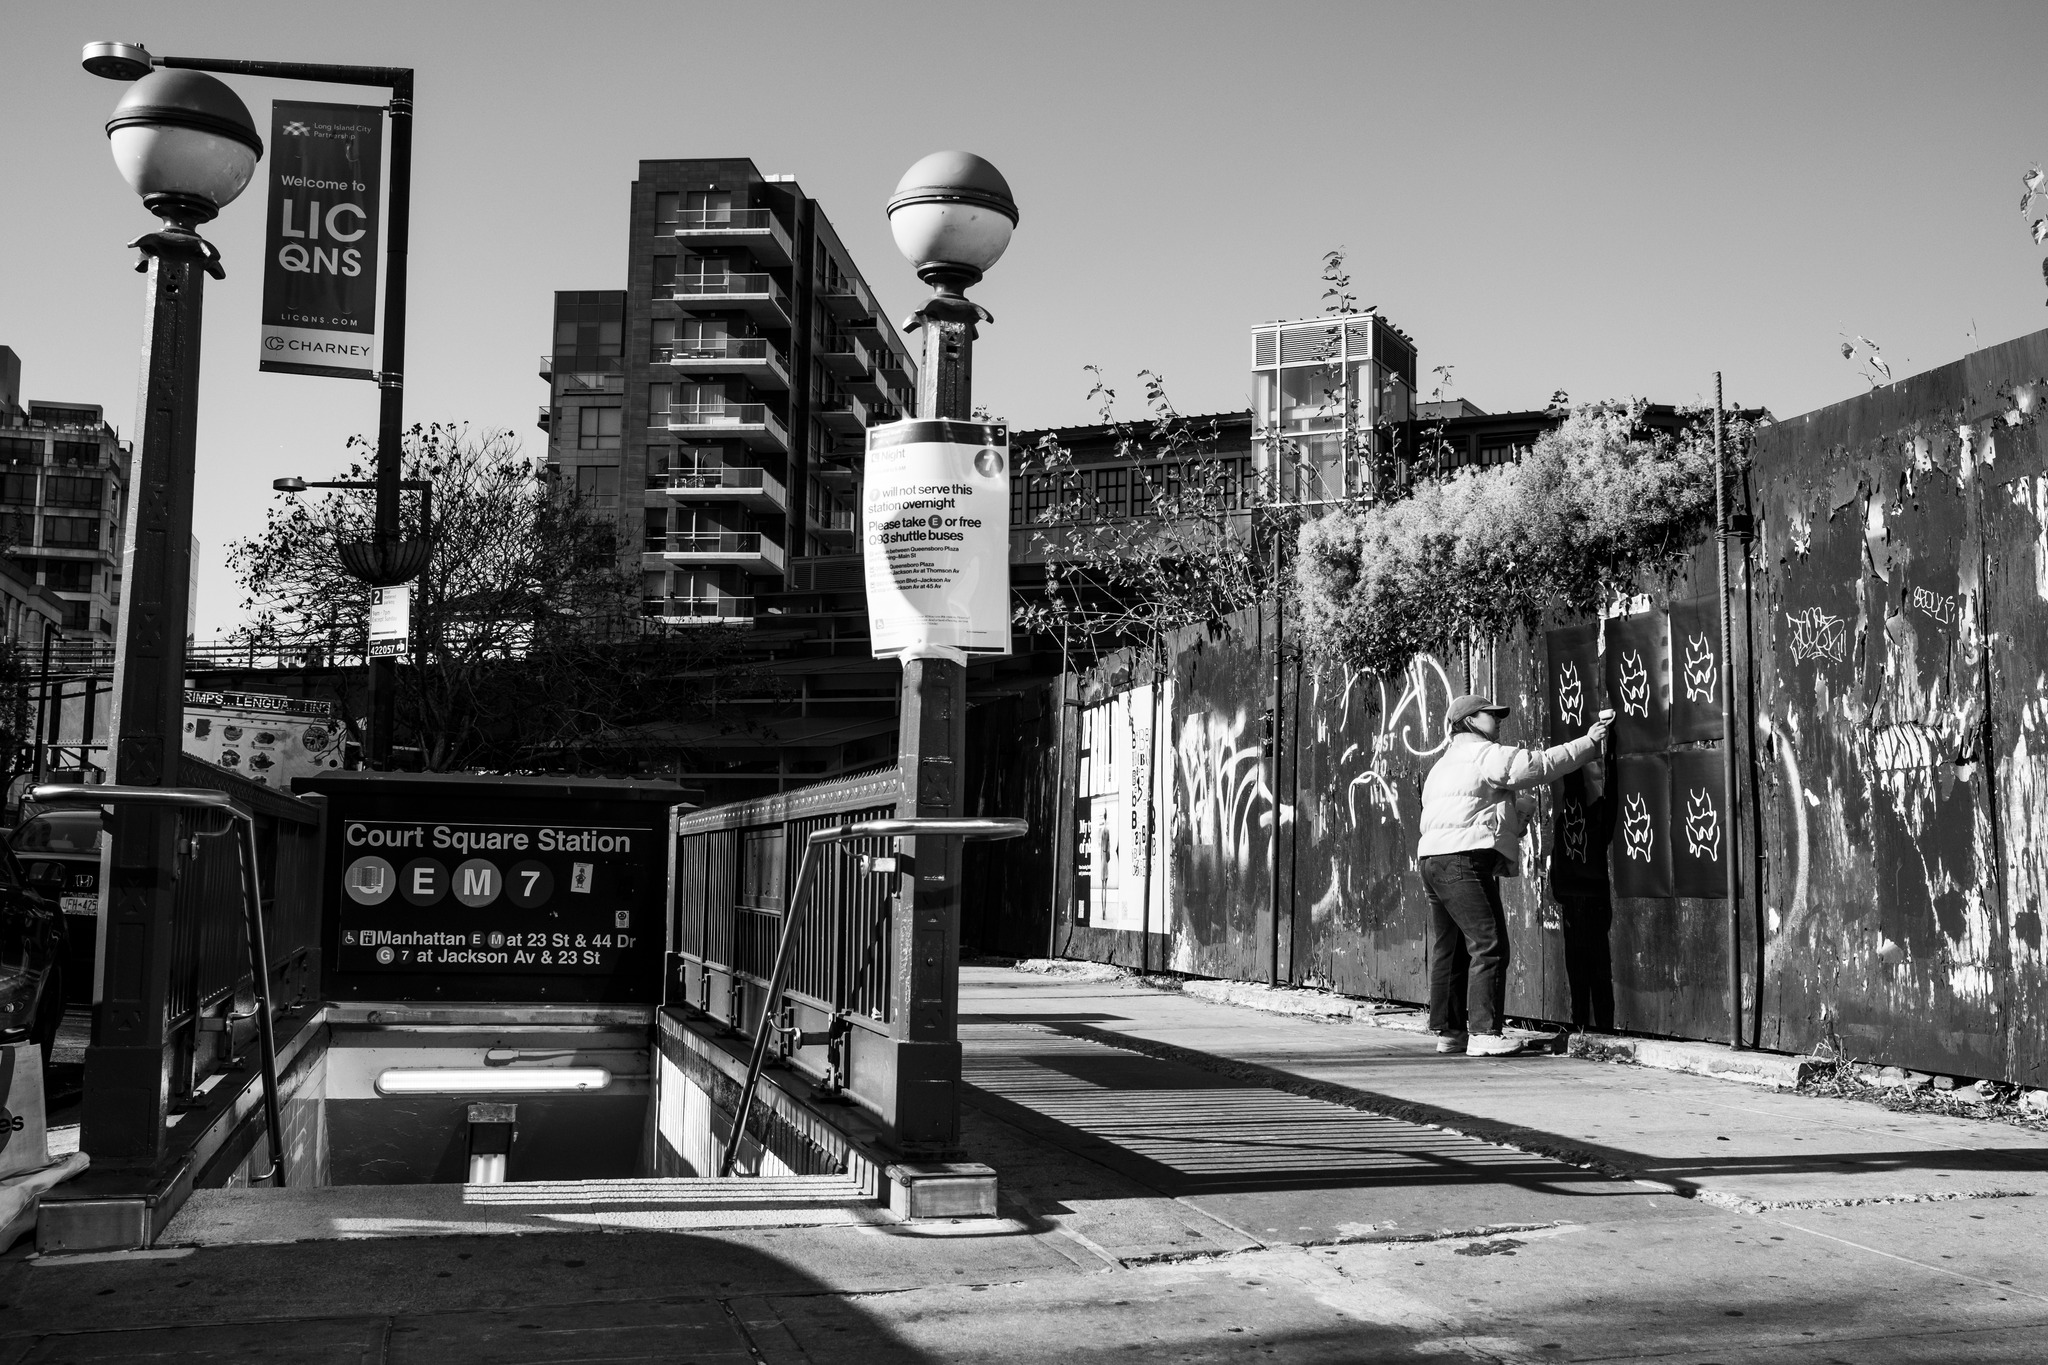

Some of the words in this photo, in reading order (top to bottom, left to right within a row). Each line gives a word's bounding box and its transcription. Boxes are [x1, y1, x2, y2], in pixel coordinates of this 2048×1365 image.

[313, 130, 356, 141] Partnrshp
[314, 122, 332, 133] Long
[334, 123, 355, 133] Island
[356, 124, 372, 134] City
[281, 175, 348, 191] Welcome
[352, 180, 366, 192] to
[282, 199, 367, 243] LIC
[278, 243, 362, 277] QNS
[281, 313, 358, 327] LICQNS.COM
[288, 339, 371, 357] CHARNEY
[881, 448, 906, 462] Night
[984, 454, 995, 471] 7
[882, 487, 898, 498] will
[899, 485, 916, 496] not
[918, 485, 950, 495] serve
[952, 484, 973, 495] this
[868, 501, 901, 514] station
[902, 497, 956, 511] overnight
[868, 518, 900, 532] Please
[902, 516, 926, 528] take
[944, 517, 958, 527] or
[959, 516, 982, 528] free
[869, 533, 890, 546] Q93
[890, 530, 927, 543] shuttle
[928, 529, 964, 541] buses
[889, 562, 919, 570] Queensboro
[374, 590, 380, 604] 2
[370, 645, 395, 655] 422057
[346, 823, 424, 848] Court
[433, 825, 530, 855] Square
[537, 828, 631, 853] Station
[413, 867, 435, 895] E
[463, 868, 491, 896] M
[521, 871, 541, 897] 7
[376, 930, 466, 946] Manhattan
[490, 934, 502, 945] M
[506, 933, 523, 947] at
[527, 933, 547, 947] 23
[551, 933, 570, 948] St
[574, 933, 587, 948] &
[591, 933, 612, 948] 44
[616, 933, 637, 949] Dr
[380, 950, 391, 961] G
[416, 950, 433, 963] at
[437, 949, 508, 964] Jackson
[513, 950, 536, 964] Av
[540, 951, 553, 964] &
[557, 950, 578, 965] 23
[582, 950, 601, 965] St
